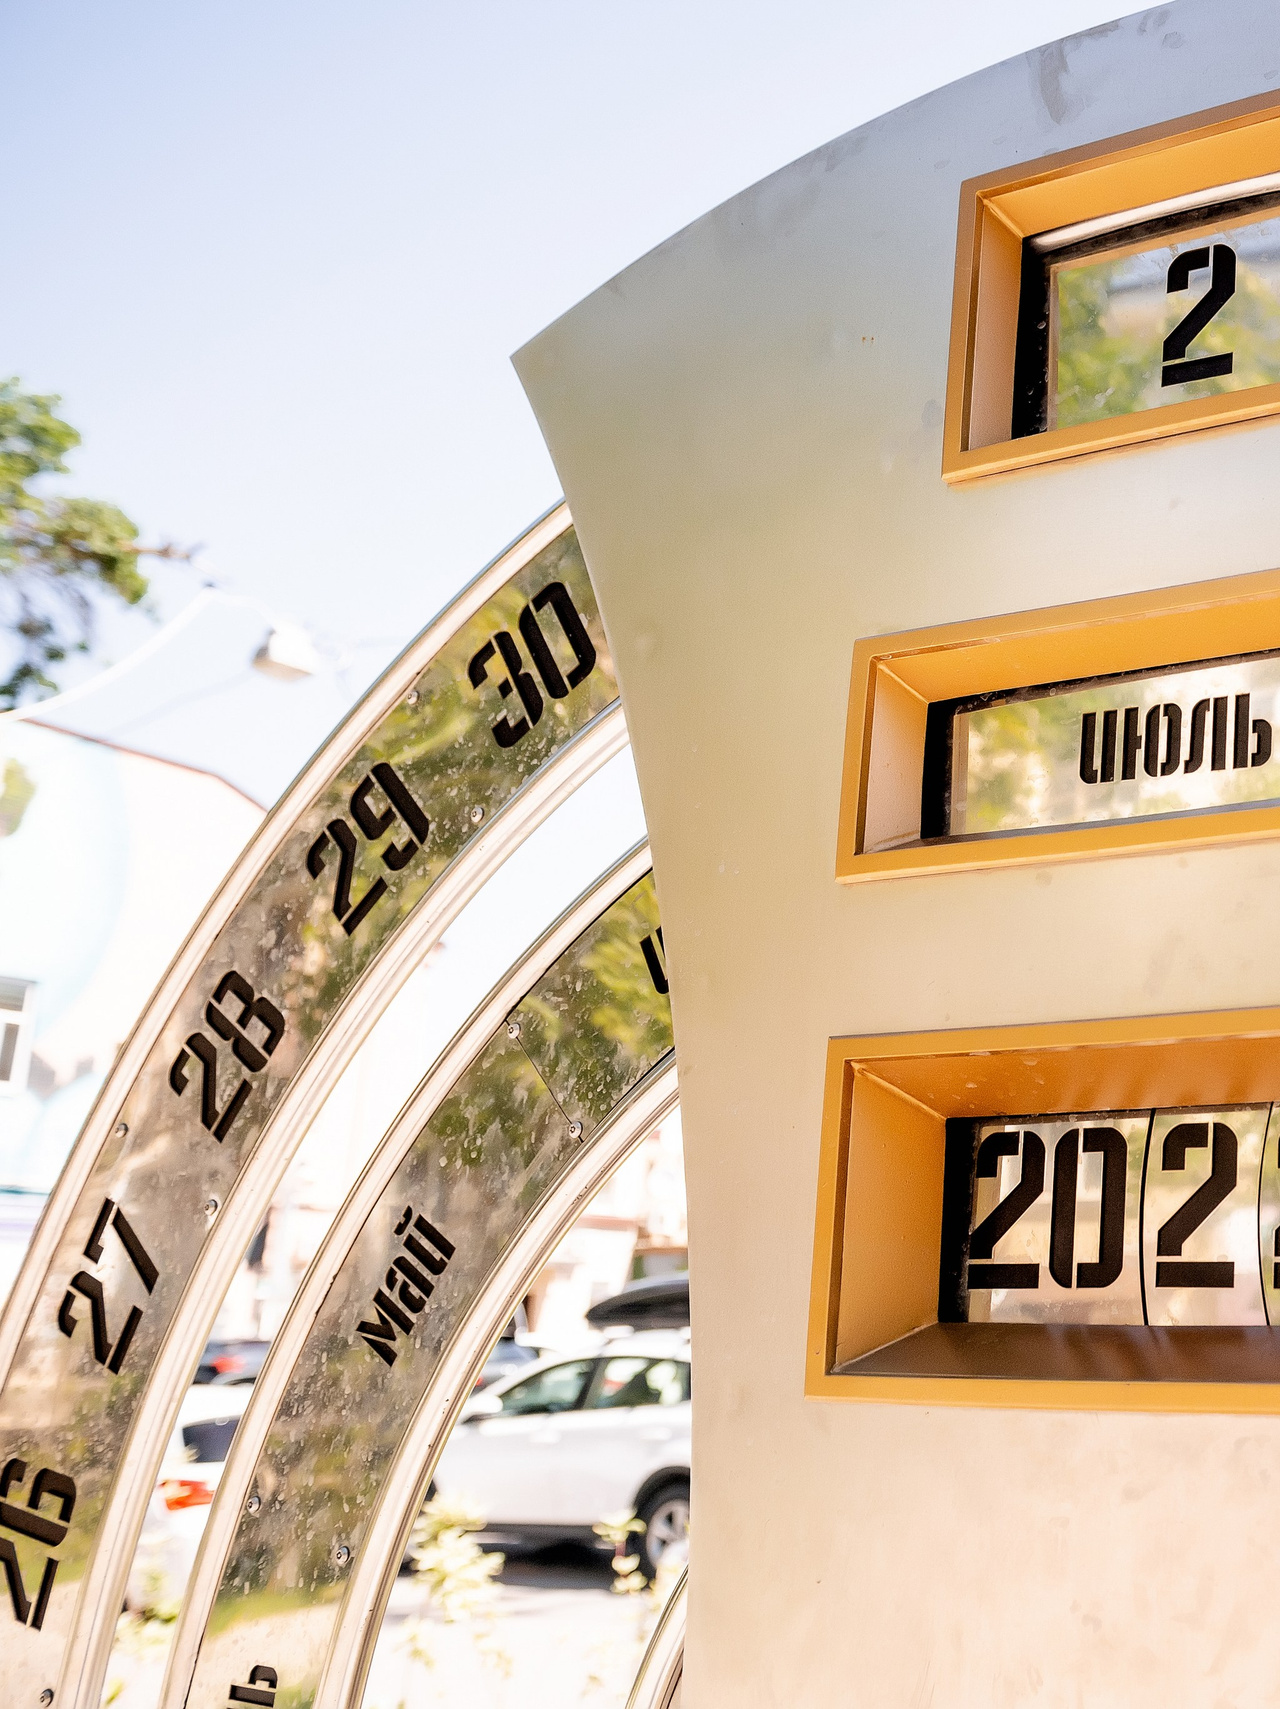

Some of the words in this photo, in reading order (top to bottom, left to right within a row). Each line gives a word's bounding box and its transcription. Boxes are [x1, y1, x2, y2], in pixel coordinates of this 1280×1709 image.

[1161, 243, 1237, 388] 2
[467, 581, 597, 749] 30
[1079, 692, 1273, 785] июль
[305, 761, 431, 937] 29
[168, 969, 286, 1144] 28
[57, 1197, 159, 1376] 27
[355, 1204, 457, 1368] май
[0, 1457, 77, 1632] 26
